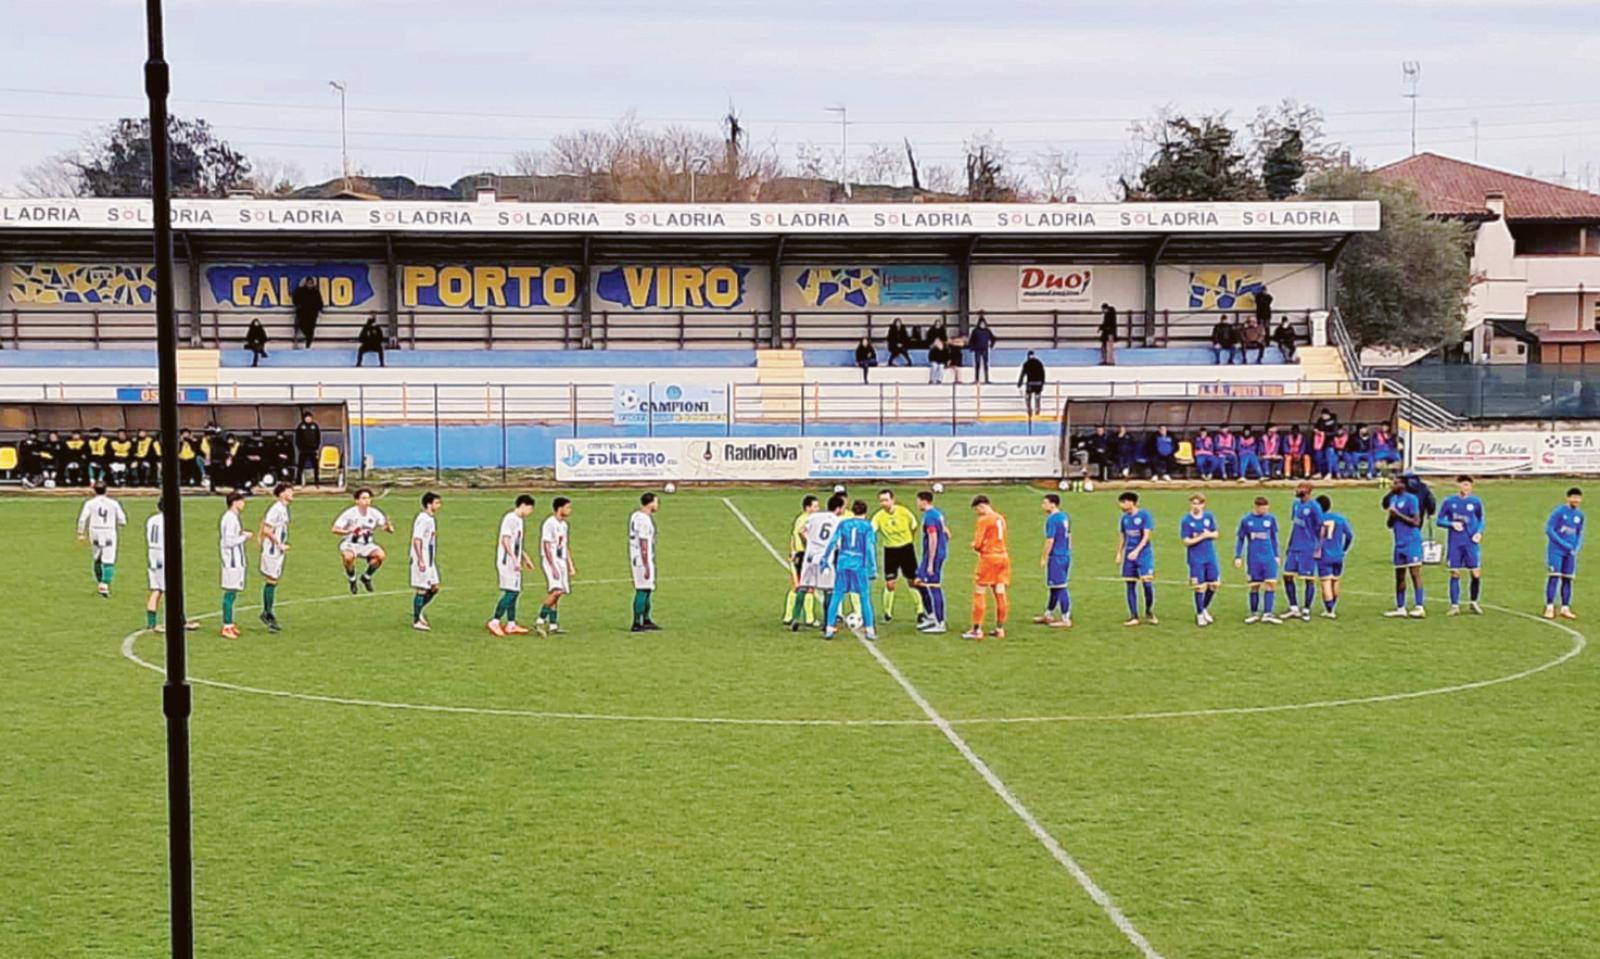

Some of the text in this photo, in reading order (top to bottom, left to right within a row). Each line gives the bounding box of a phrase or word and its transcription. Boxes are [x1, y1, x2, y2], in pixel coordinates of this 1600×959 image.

[107, 208, 213, 223] SOLDRIA
[239, 209, 343, 224] SOLADRIA
[369, 210, 472, 225] SOLADRIA
[498, 211, 599, 226] SOLADRIA
[625, 212, 725, 226] SOLADRIA
[750, 212, 849, 226] SOLADRIA
[874, 212, 973, 226] SOLADRIA
[998, 212, 1096, 226] SOLADRIA
[1120, 211, 1218, 226] SOLADRIA
[1243, 211, 1341, 225] SOLADRIA
[232, 266, 739, 308] CALIO PORTO VIRO
[1561, 436, 1594, 447] SEA
[587, 452, 666, 467] EDILFERRO
[724, 444, 798, 461] RadioDiva
[819, 523, 831, 541] 6
[995, 519, 1004, 540] 1
